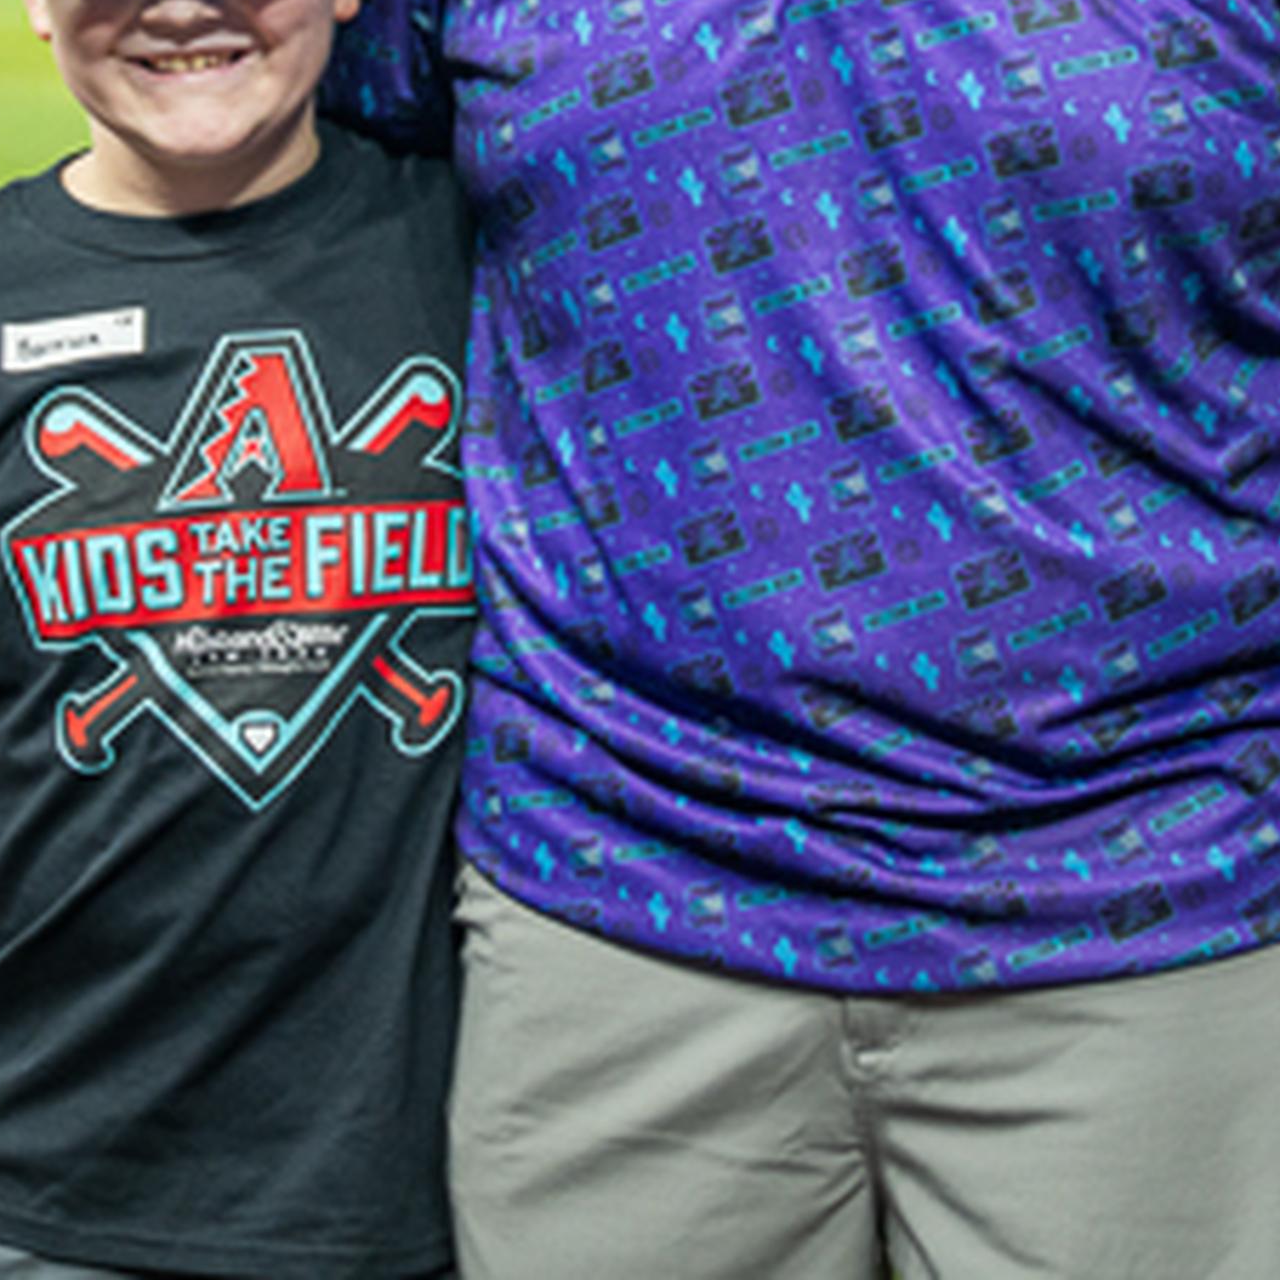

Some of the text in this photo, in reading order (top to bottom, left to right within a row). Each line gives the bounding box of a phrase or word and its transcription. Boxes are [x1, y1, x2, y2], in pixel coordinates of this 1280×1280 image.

[189, 516, 292, 555] TAKE
[21, 527, 184, 624] KIDS
[193, 556, 292, 606] THE
